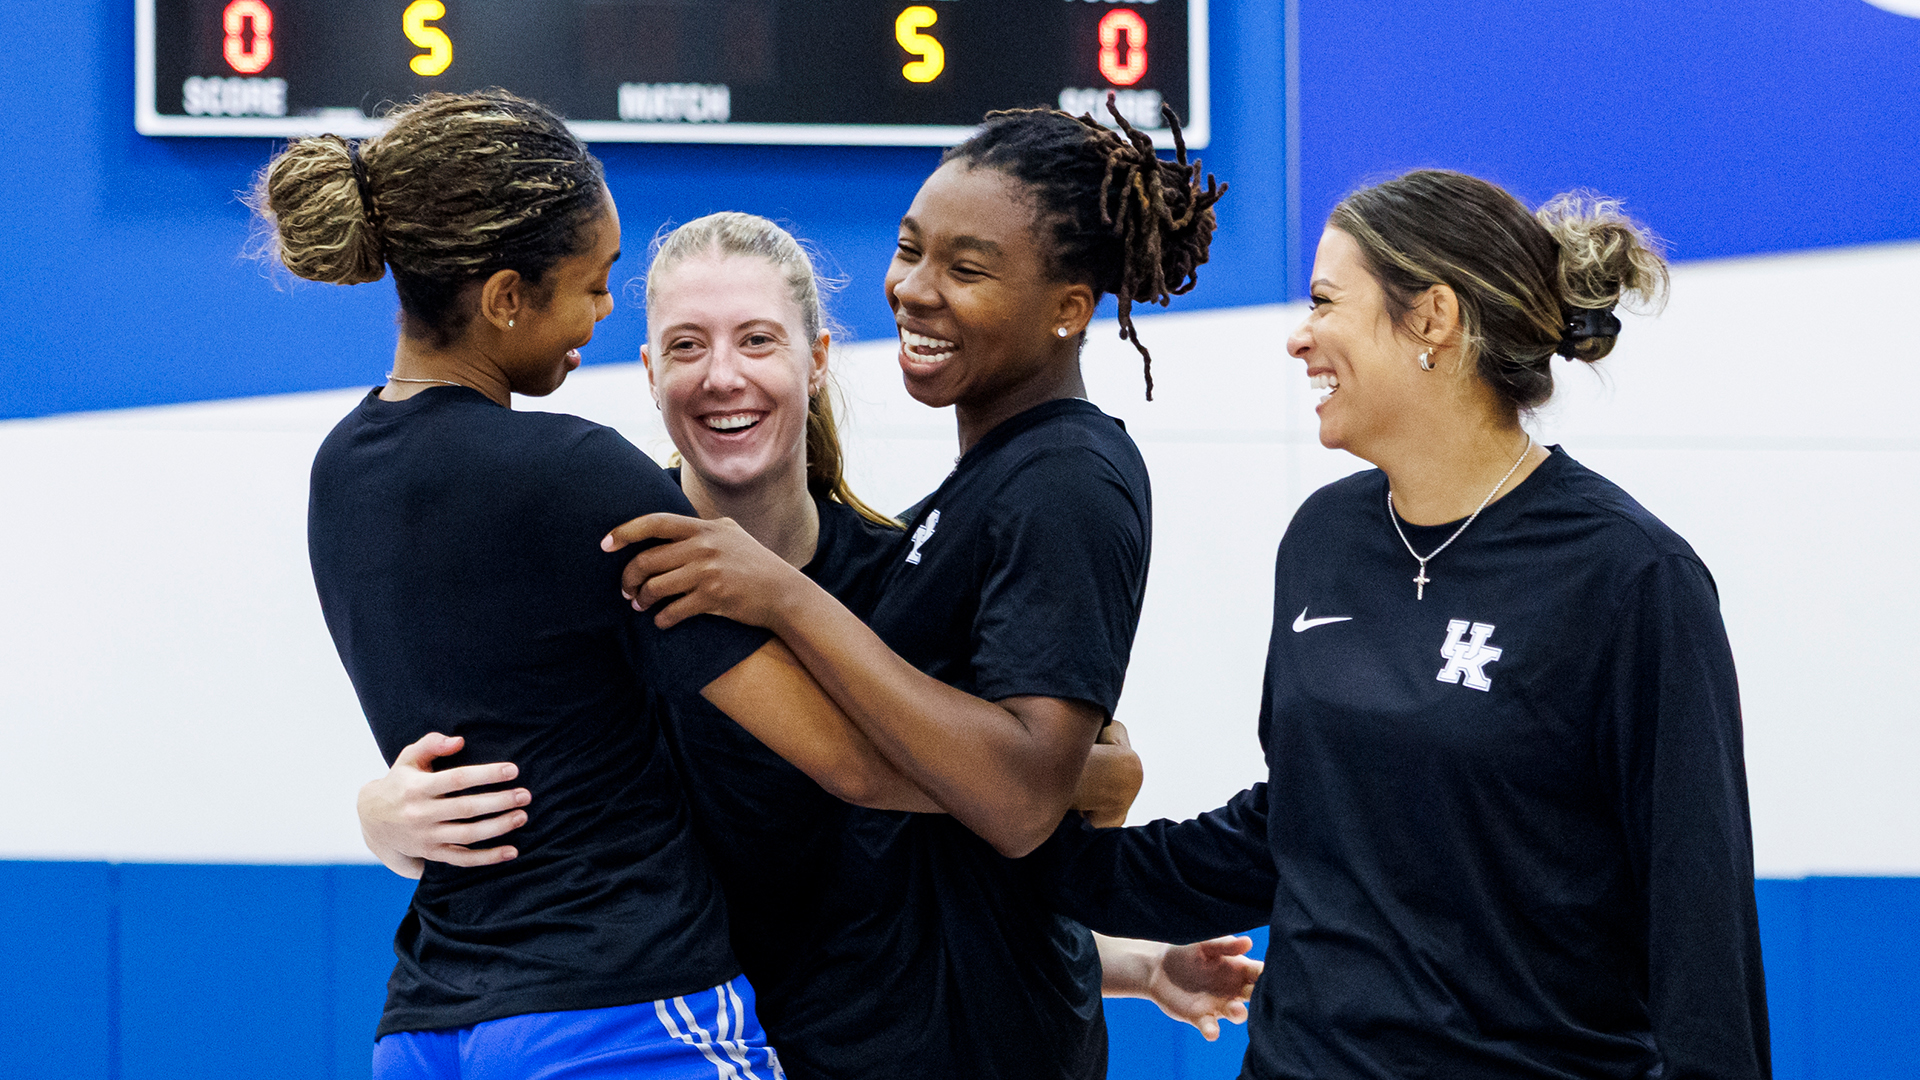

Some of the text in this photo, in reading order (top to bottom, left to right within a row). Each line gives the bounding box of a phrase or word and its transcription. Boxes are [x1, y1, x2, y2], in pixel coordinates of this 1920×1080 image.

[222, 0, 274, 74] 0
[1098, 8, 1148, 86] 0
[183, 76, 288, 116] SCORE
[618, 82, 730, 122] MATCH
[1436, 618, 1502, 692] UK
